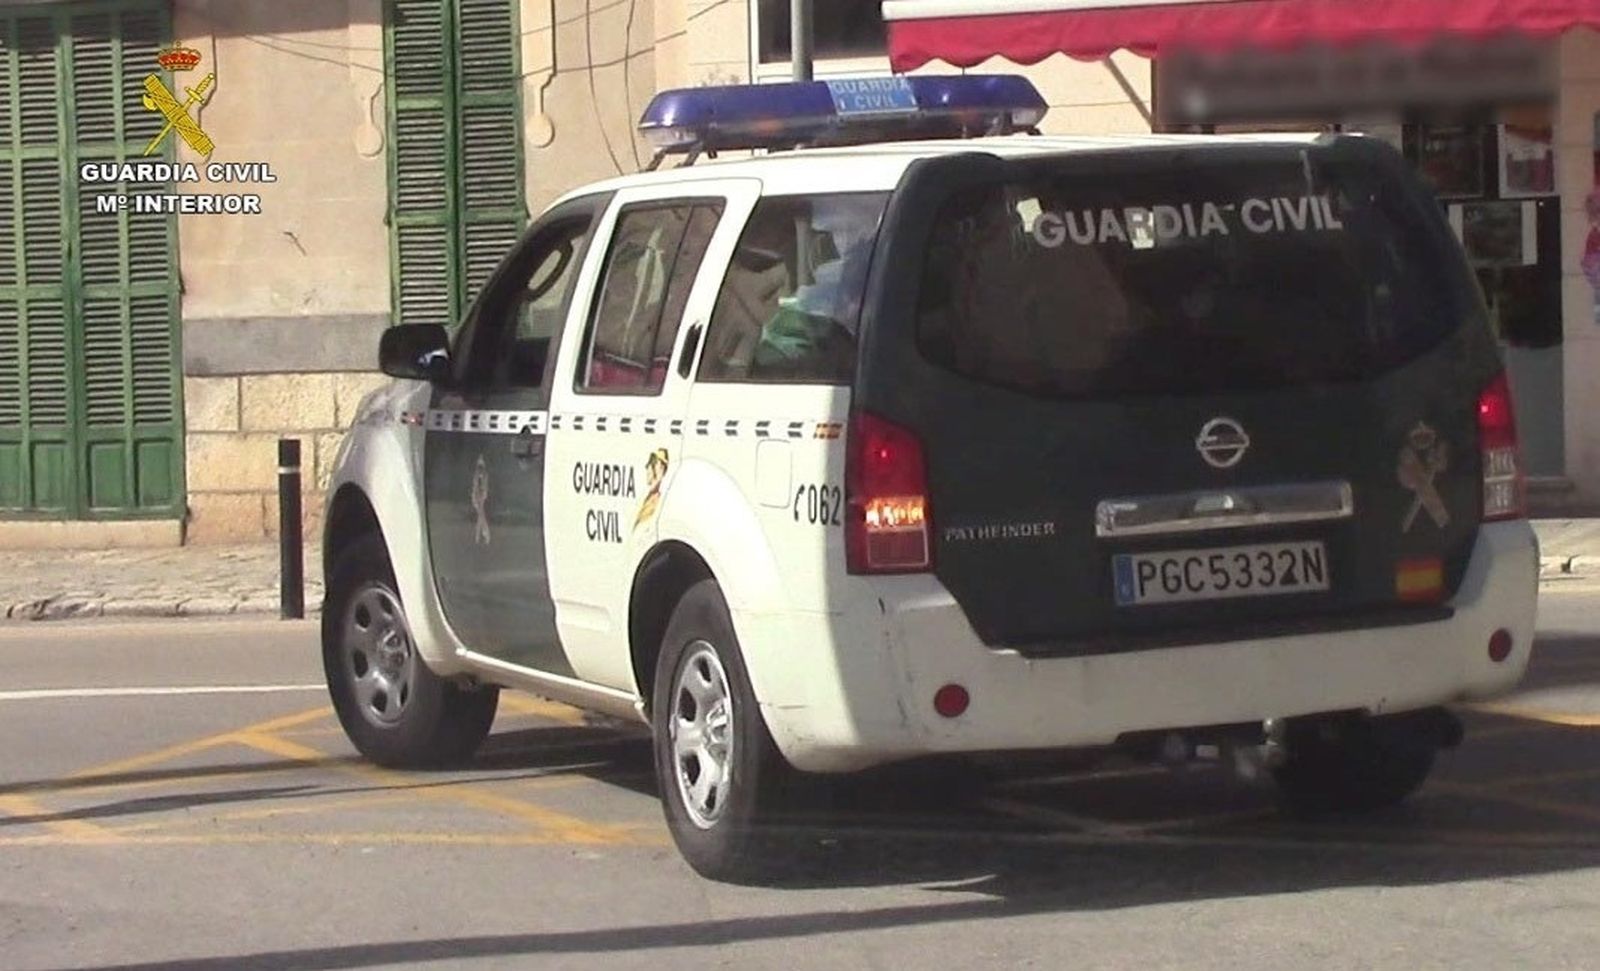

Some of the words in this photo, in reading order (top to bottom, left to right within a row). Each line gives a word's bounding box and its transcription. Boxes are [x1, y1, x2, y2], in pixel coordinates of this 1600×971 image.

[832, 78, 910, 94] GUARDIA
[855, 94, 898, 110] CIVIL
[1033, 201, 1230, 248] GUARDIA
[1240, 196, 1343, 233] CIVIL
[573, 461, 636, 498] GUARDIA
[807, 483, 841, 526] 062
[586, 508, 622, 543] CIVIL
[945, 521, 1055, 541] PATHFINDER
[1137, 547, 1324, 597] PGC5332N
